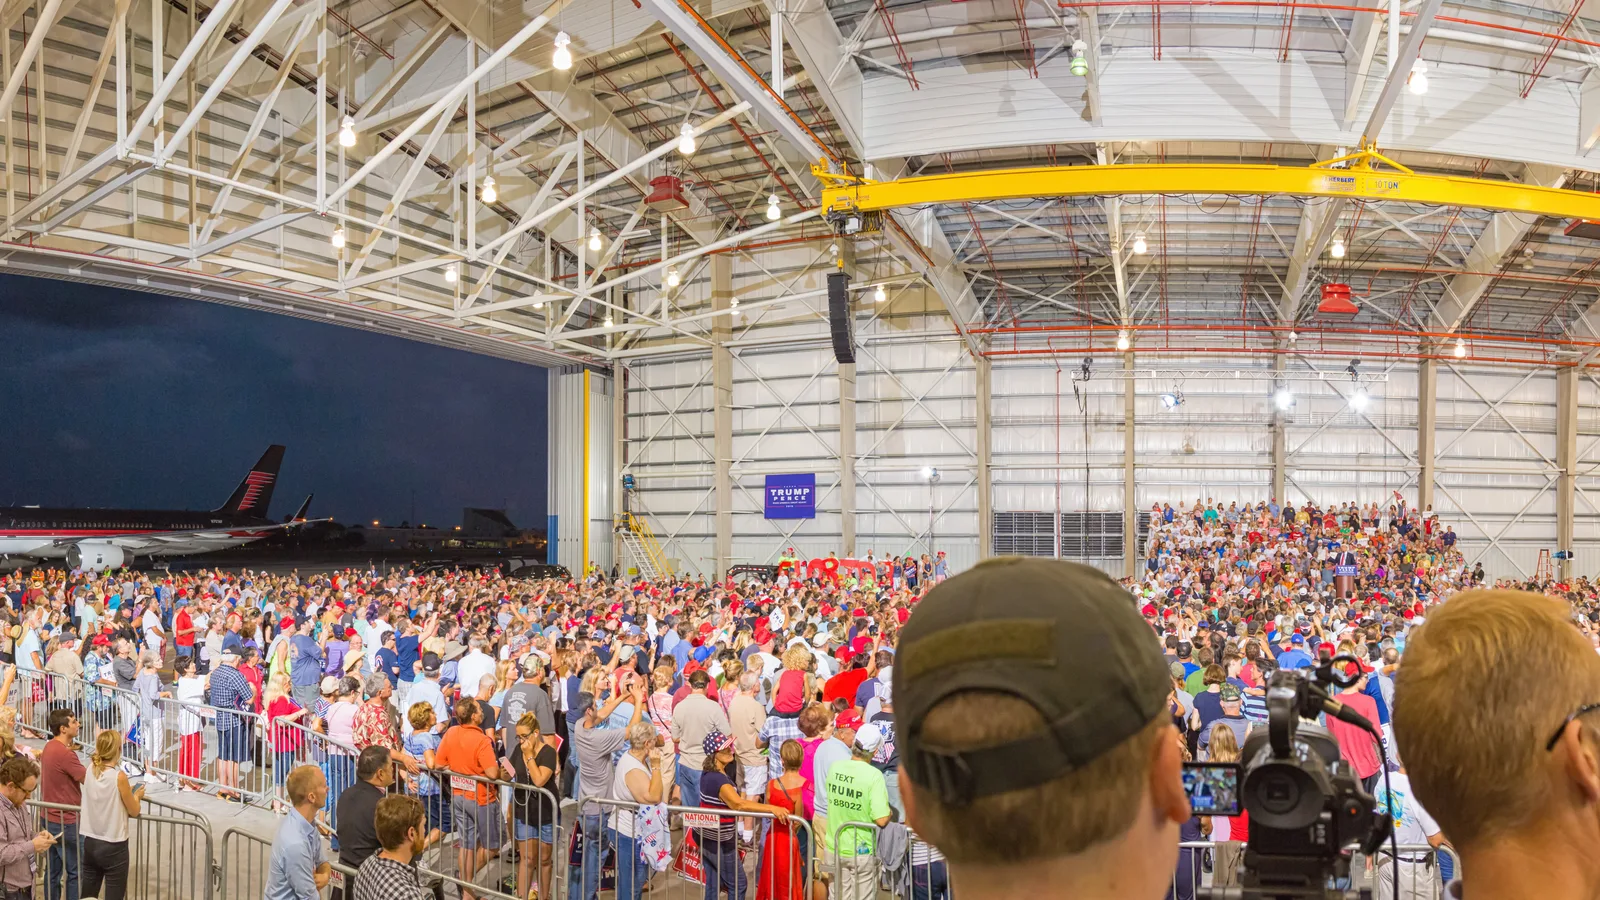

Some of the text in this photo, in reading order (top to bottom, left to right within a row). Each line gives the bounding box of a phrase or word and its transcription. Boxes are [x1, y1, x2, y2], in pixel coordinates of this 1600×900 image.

[1384, 181, 1398, 189] TON
[770, 488, 810, 496] TRUMP
[452, 775, 475, 787] NATIONAL
[835, 772, 855, 784] TEXT
[828, 783, 863, 799] TRUMP
[833, 798, 862, 811] 88022
[684, 813, 718, 822] NATIONAL
